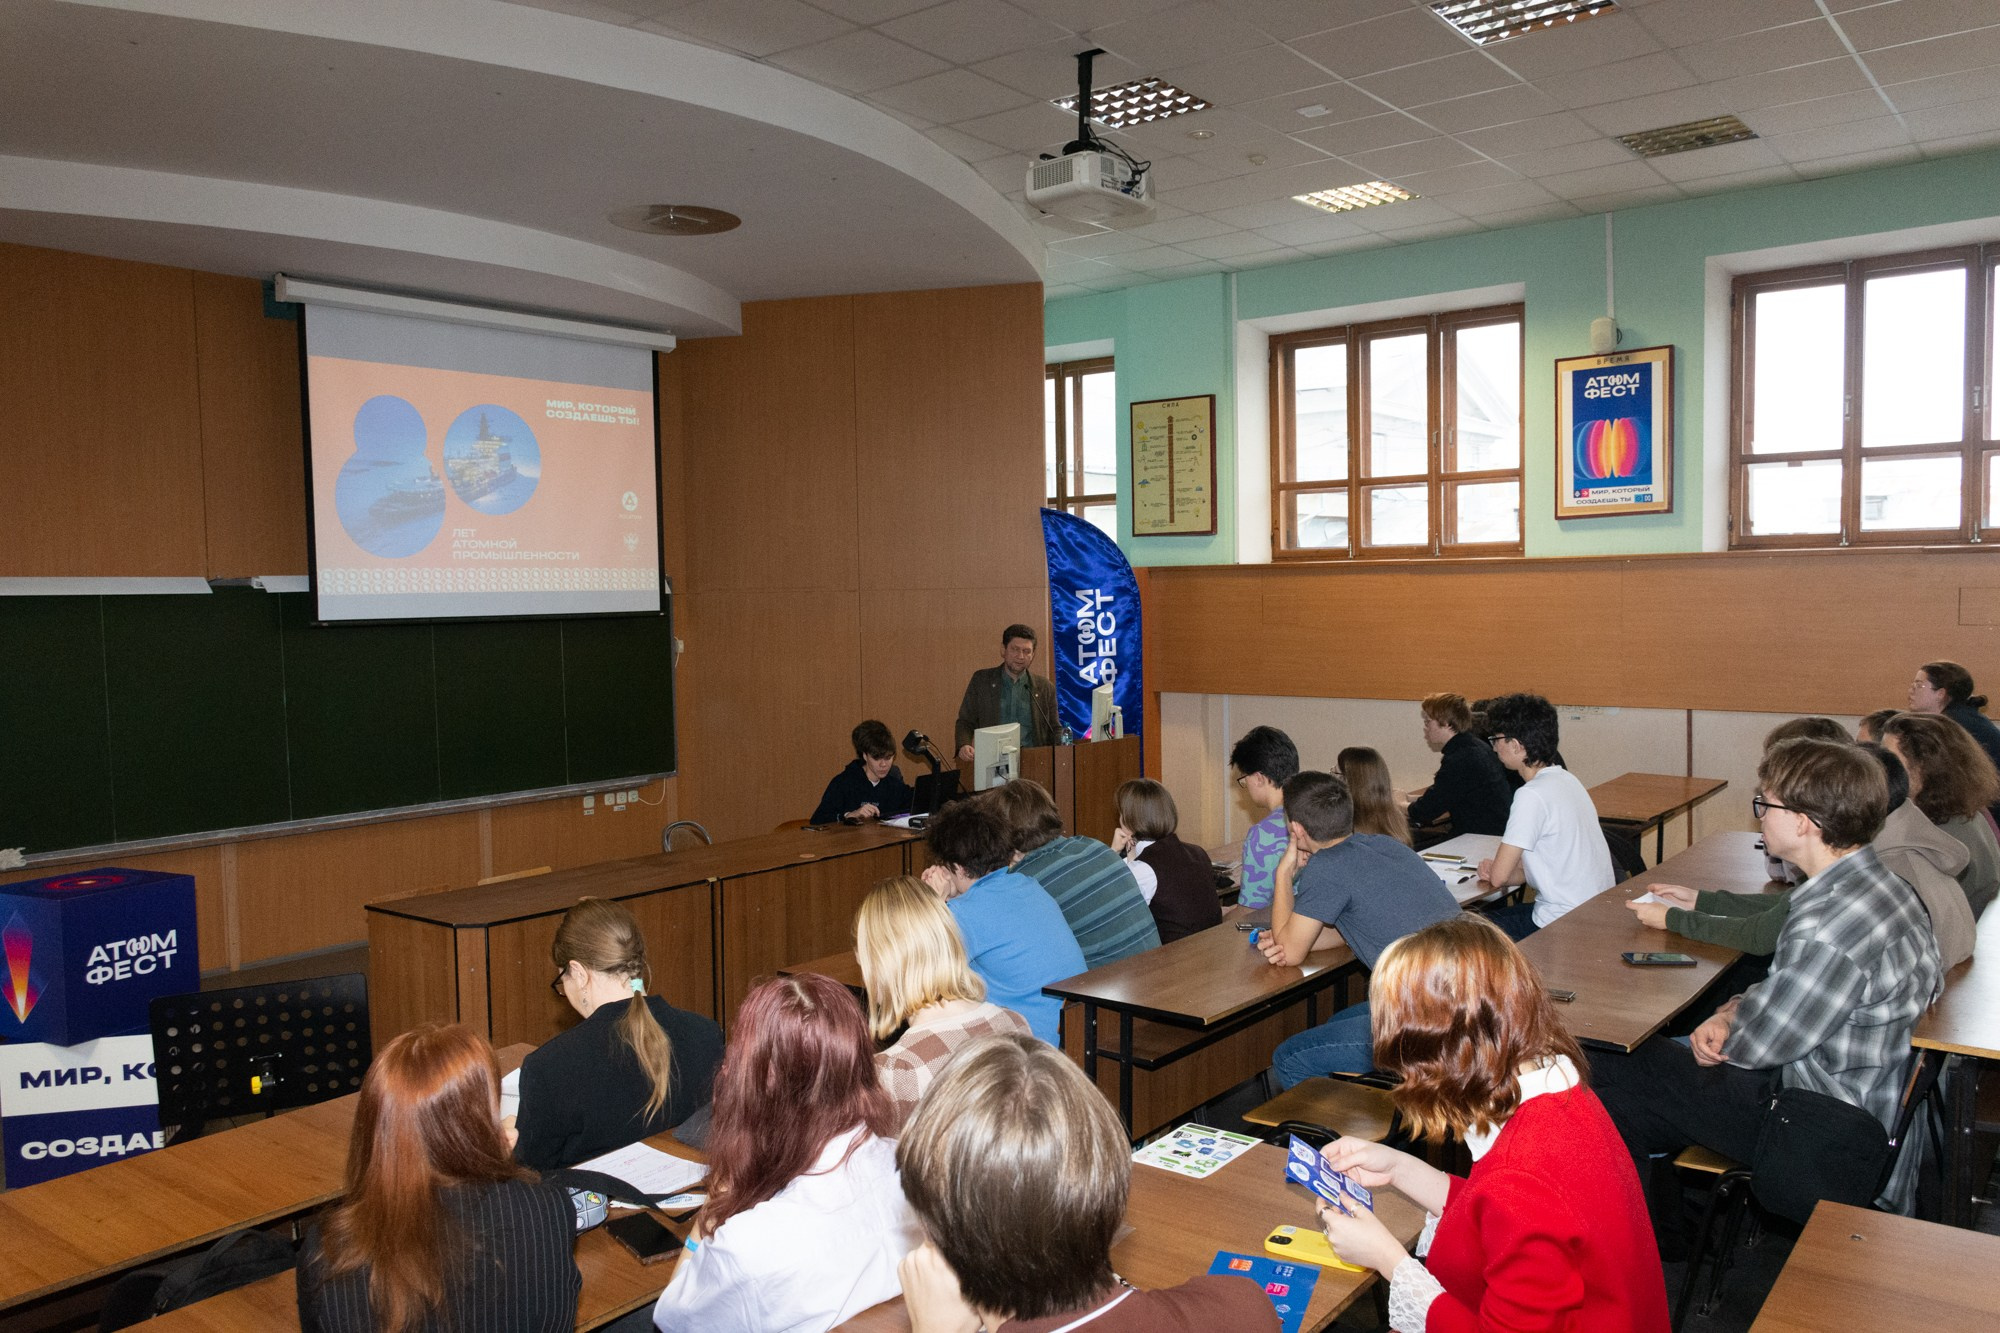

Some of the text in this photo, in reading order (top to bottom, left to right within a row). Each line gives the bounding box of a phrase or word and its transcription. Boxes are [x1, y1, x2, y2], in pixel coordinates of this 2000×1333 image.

[1597, 355, 1630, 366] ВРЕМЯ
[1584, 384, 1640, 399] ФЕСТ
[546, 399, 637, 416] МИР, КОТОРЫЙ
[546, 409, 640, 426] СОЗДАЕШЬ ТЫ!
[1612, 486, 1650, 494] КОТОРЫЙ
[452, 528, 477, 538] ЛЕТ
[452, 537, 517, 550] АТОМНОЙ
[452, 551, 580, 561] ПРОМЫШЛЕННОСТИ
[1095, 588, 1118, 685] ФЕСТ
[86, 949, 178, 985] ФЕСТ
[20, 1066, 112, 1090] МИР,
